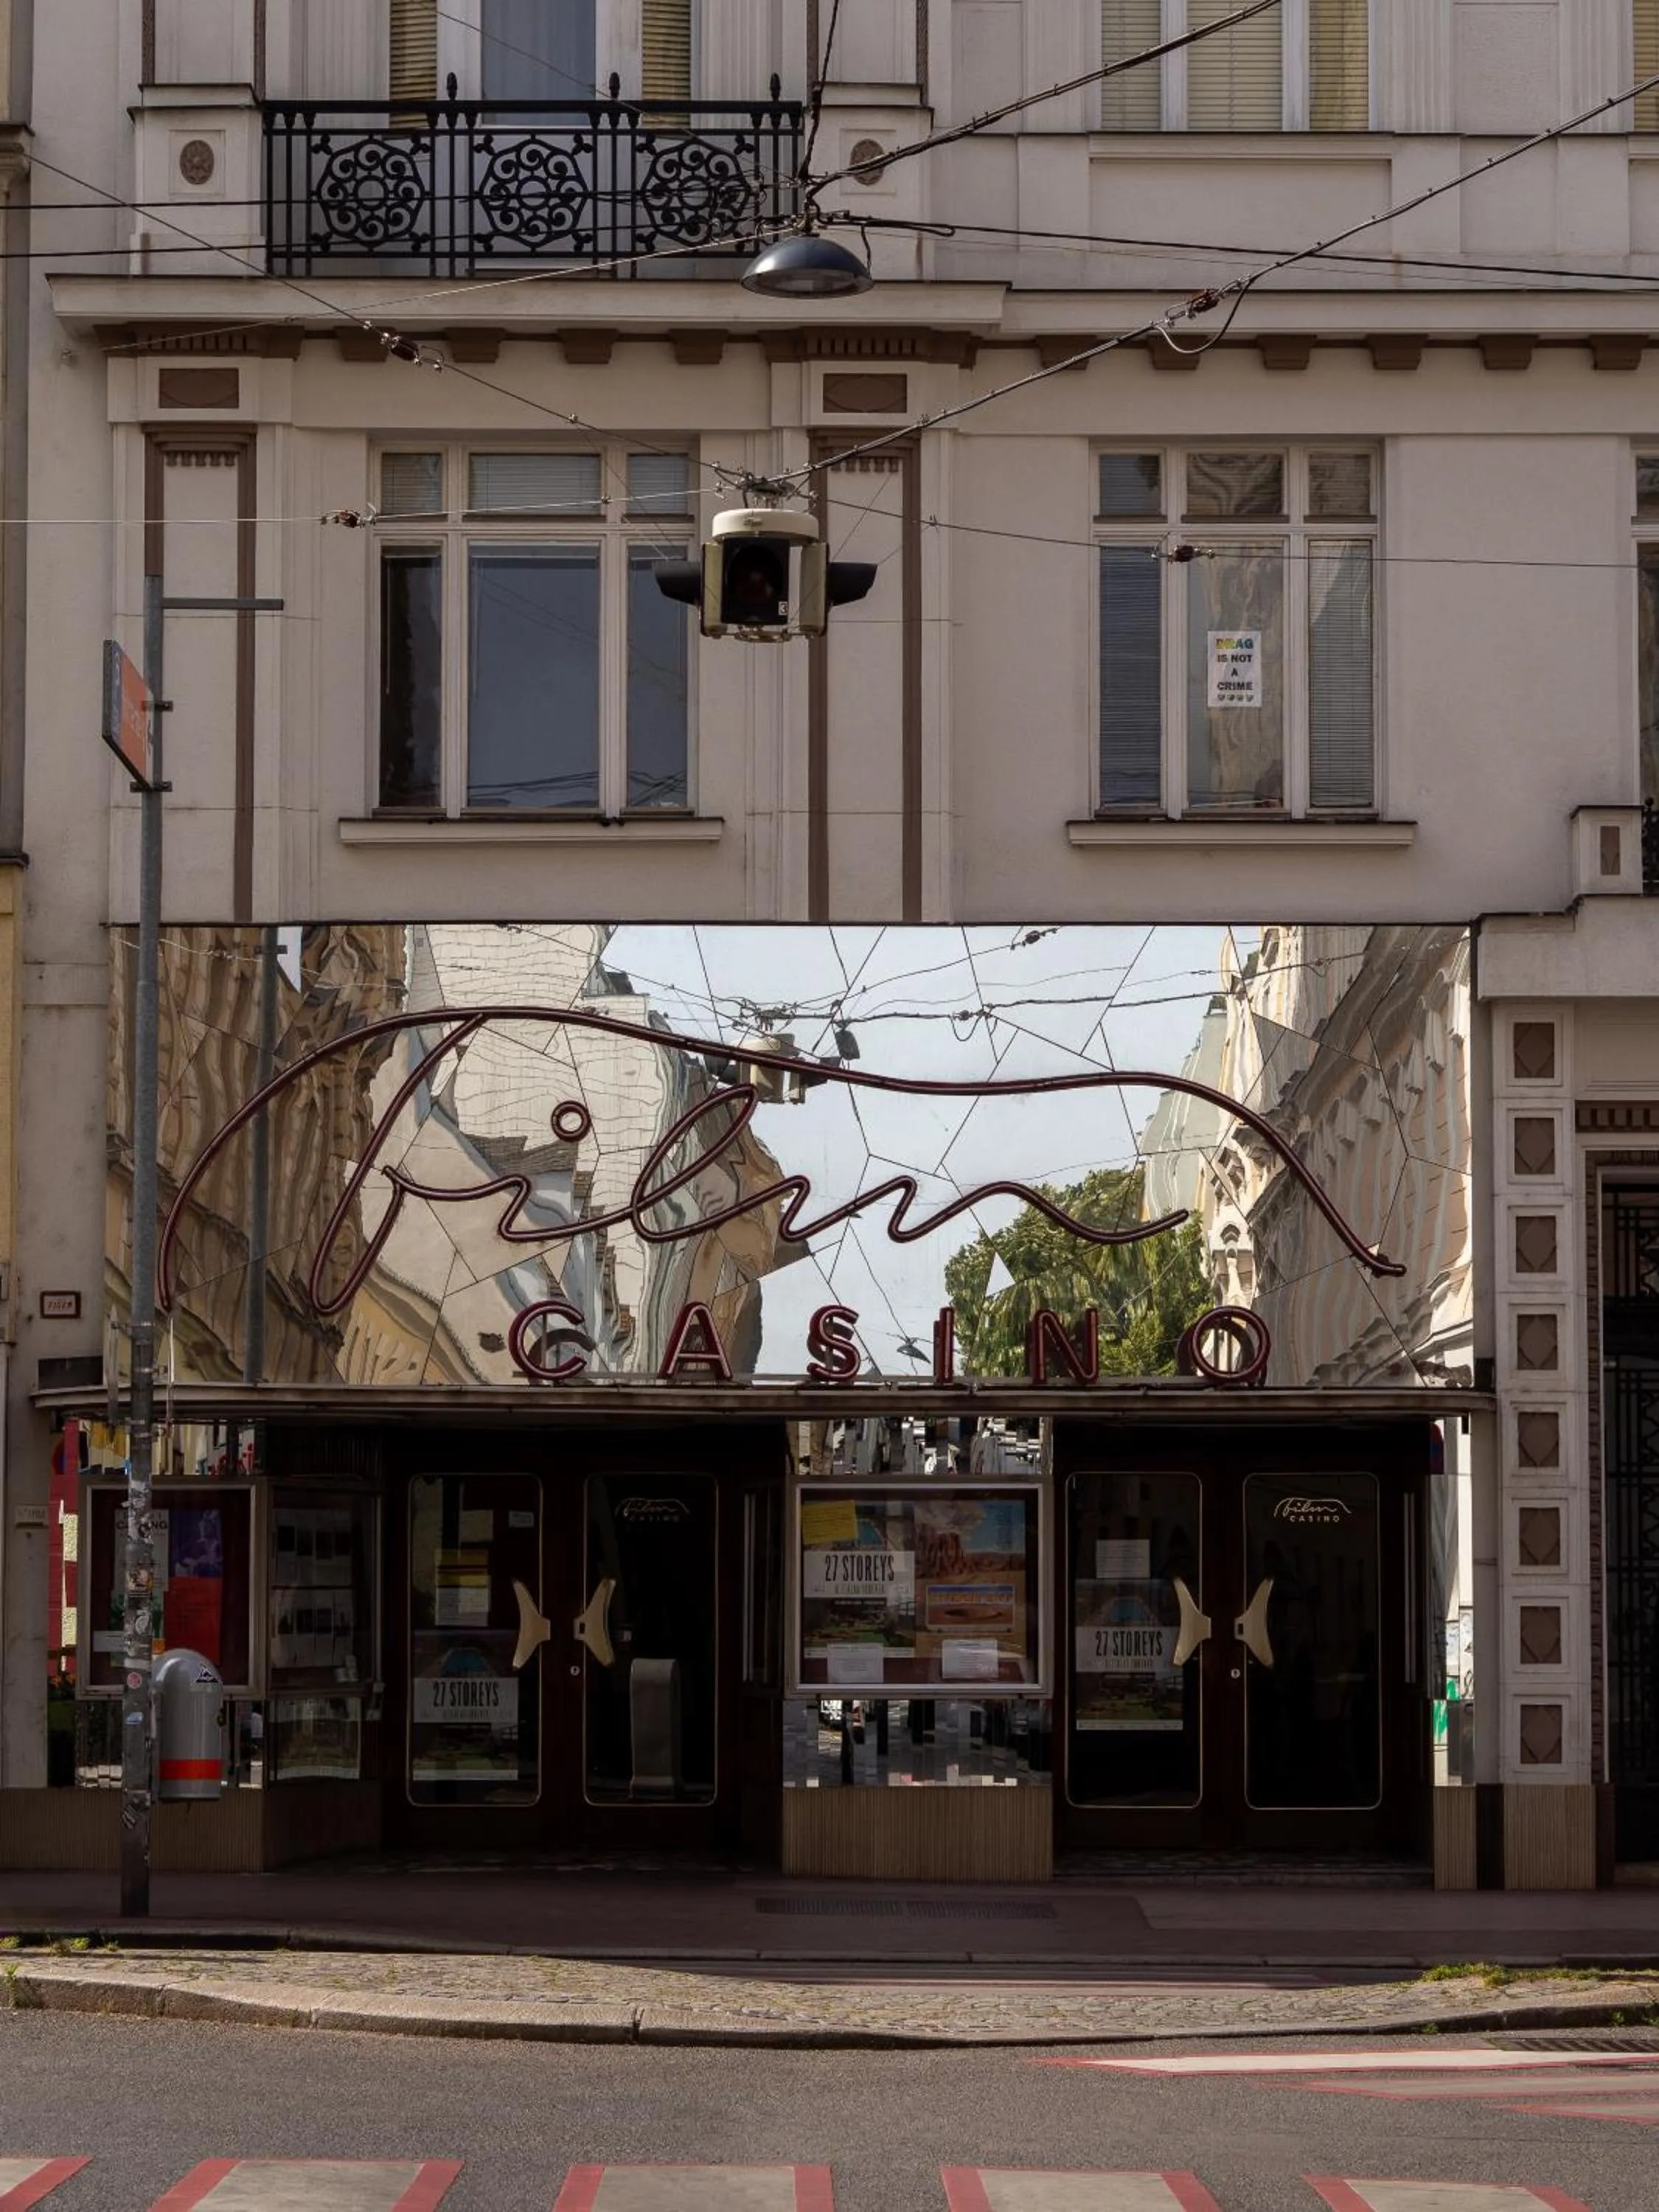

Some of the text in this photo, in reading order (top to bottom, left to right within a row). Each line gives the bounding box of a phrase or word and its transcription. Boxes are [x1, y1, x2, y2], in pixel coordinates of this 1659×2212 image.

[1217, 654, 1252, 663] IS NOT
[1231, 667, 1239, 677] A
[1217, 682, 1253, 691] CRIME
[508, 1299, 1272, 1385] CASINO
[825, 1555, 894, 1582] 27 STOREYS
[1095, 1630, 1163, 1656] 27 STOREYS
[433, 1682, 499, 1707] 27 STOREYS
